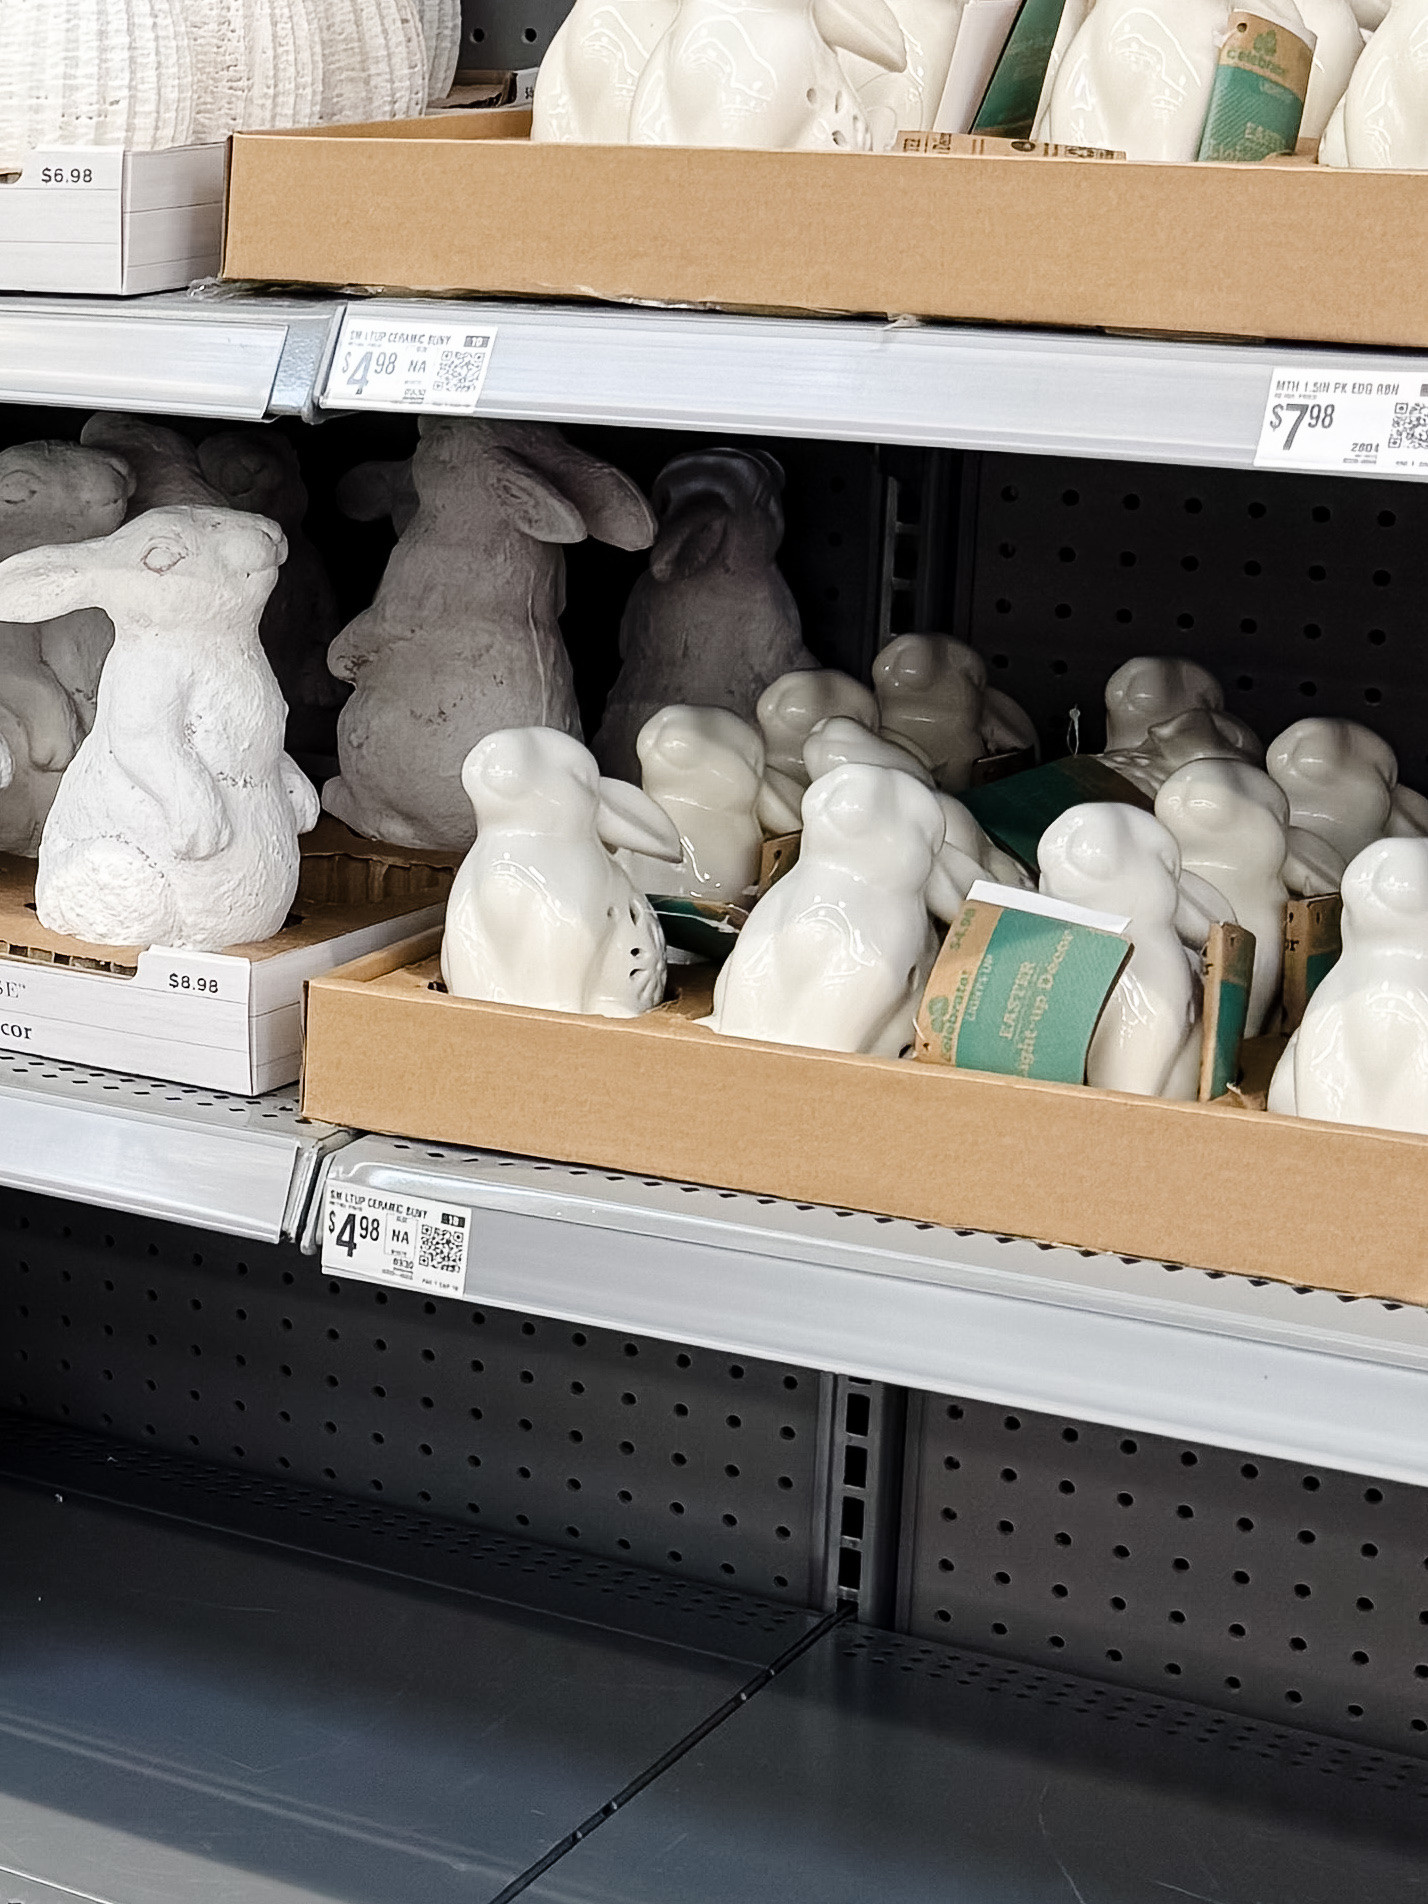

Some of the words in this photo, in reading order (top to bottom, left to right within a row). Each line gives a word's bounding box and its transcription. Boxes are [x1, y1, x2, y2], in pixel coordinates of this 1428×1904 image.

[41, 167, 93, 185] $6.98
[169, 971, 219, 995] $8.98
[999, 961, 1036, 1040] EASTER
